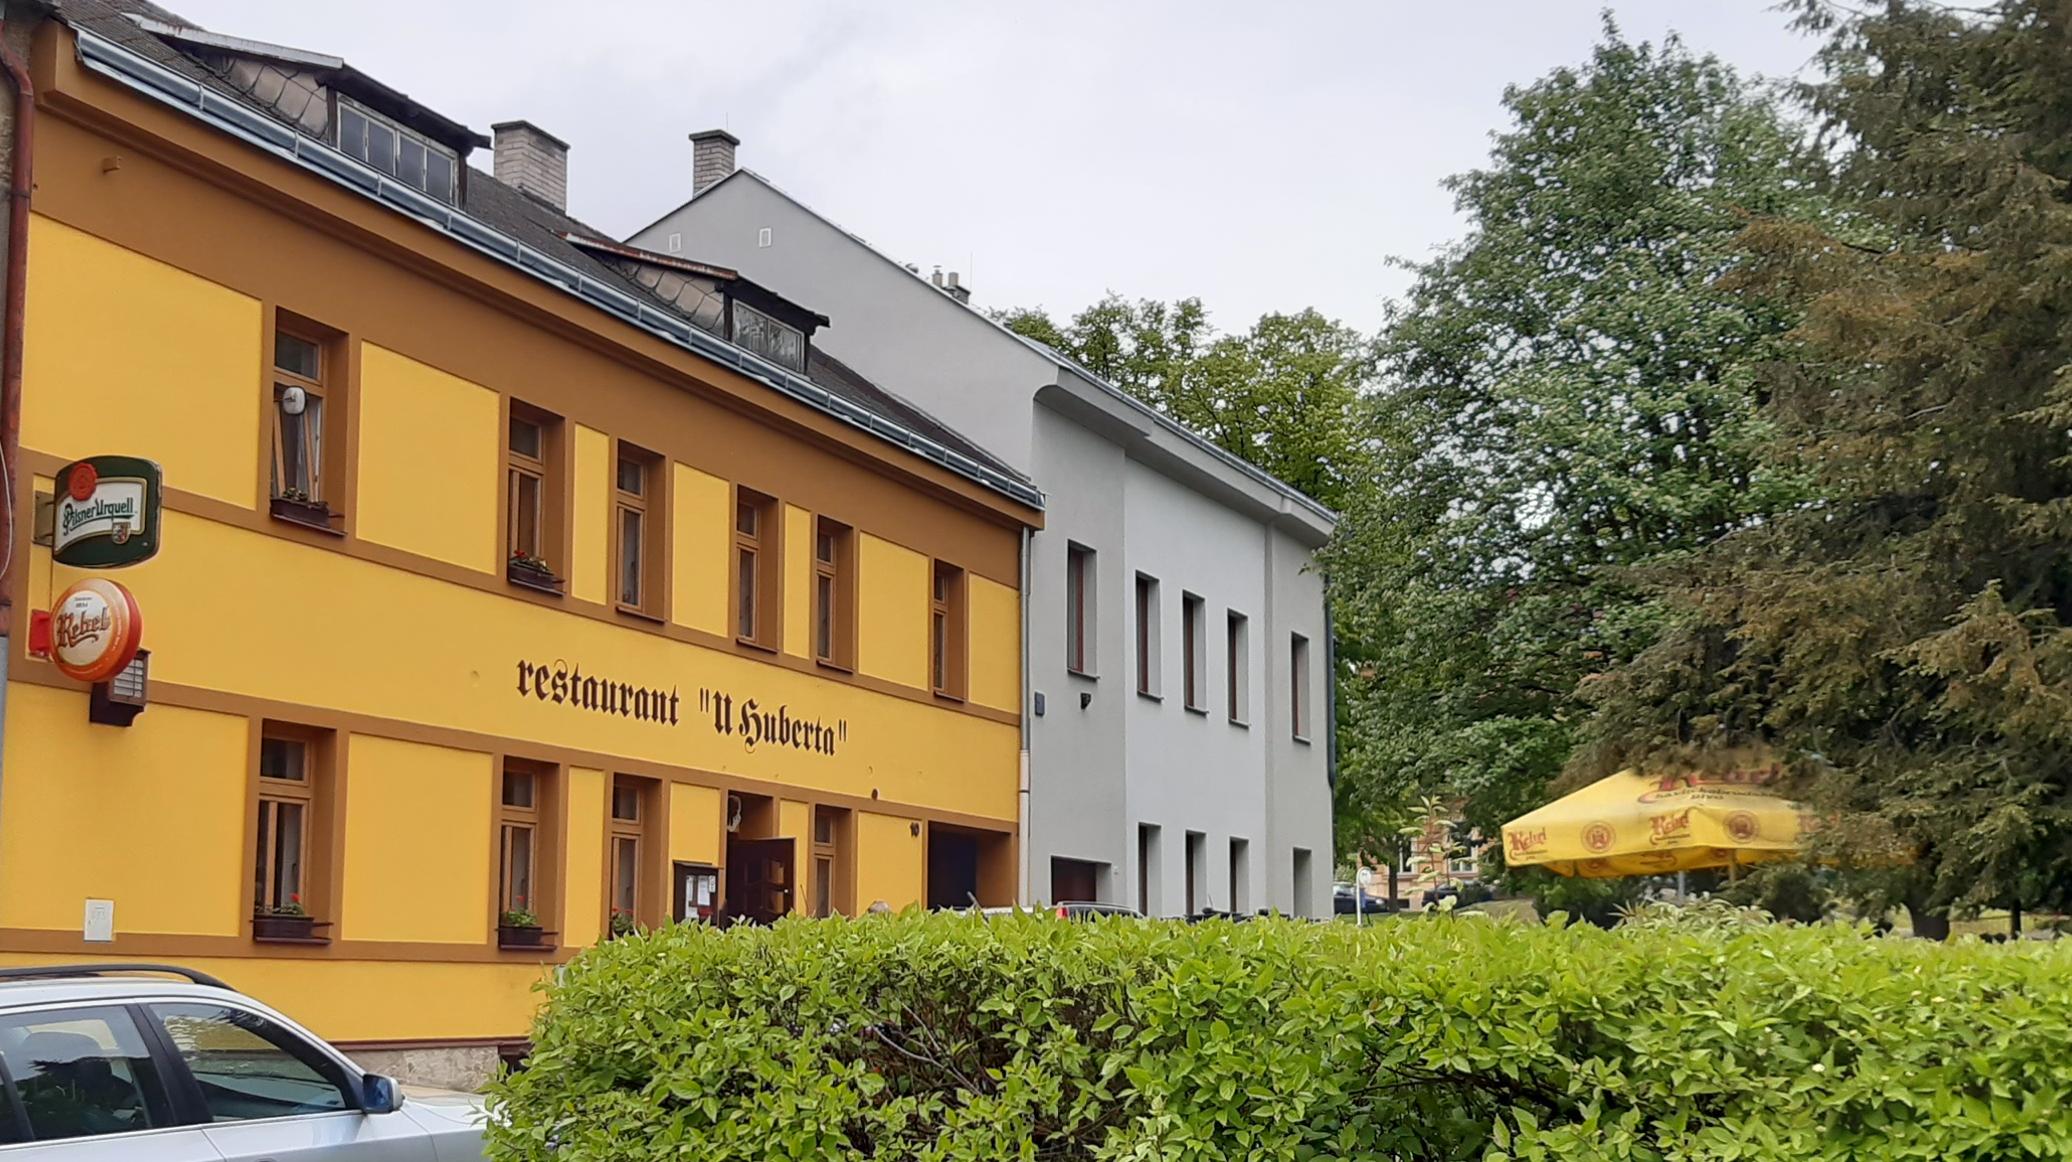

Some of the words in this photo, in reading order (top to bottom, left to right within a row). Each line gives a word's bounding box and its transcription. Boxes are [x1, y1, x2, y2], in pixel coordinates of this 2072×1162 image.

[63, 503, 96, 536] Pilsner
[95, 497, 134, 521] Urquell
[516, 658, 679, 727] restaurant
